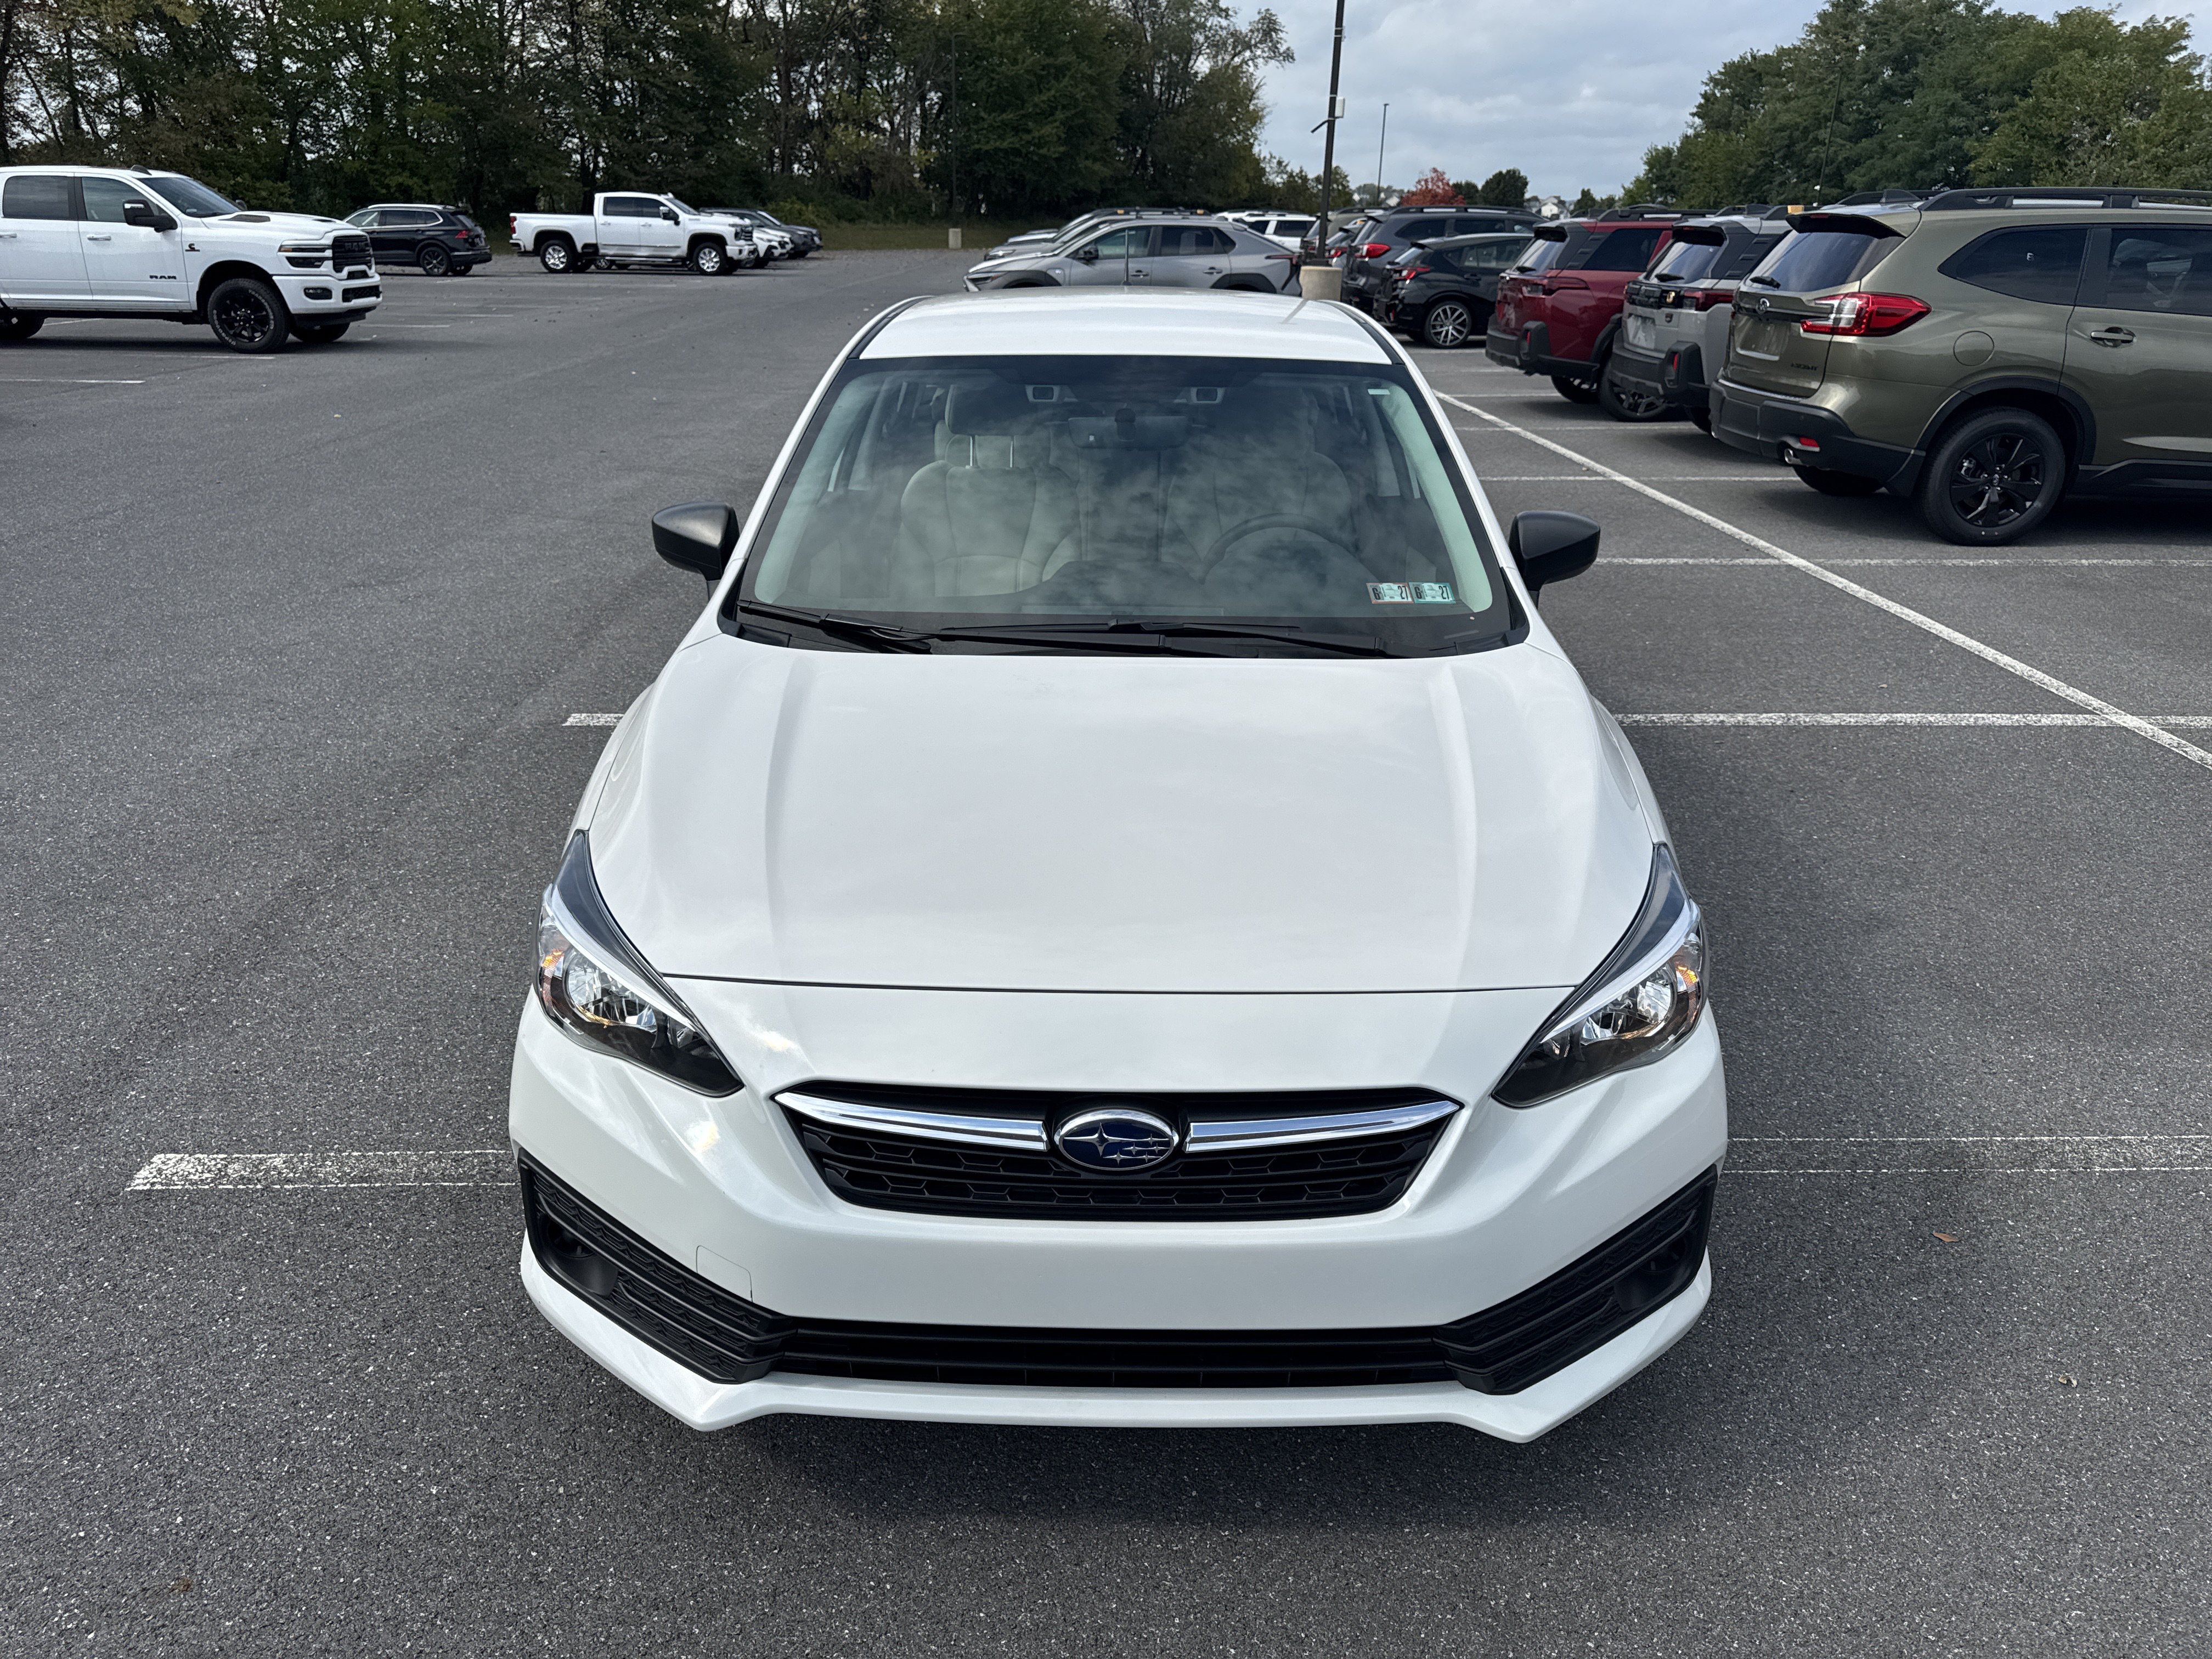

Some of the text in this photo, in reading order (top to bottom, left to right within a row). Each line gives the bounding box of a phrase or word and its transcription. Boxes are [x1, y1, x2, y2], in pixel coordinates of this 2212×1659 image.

[1372, 588, 1380, 600] 6
[1397, 585, 1408, 600] 27
[1414, 586, 1422, 599] 6
[1438, 585, 1449, 600] 27
